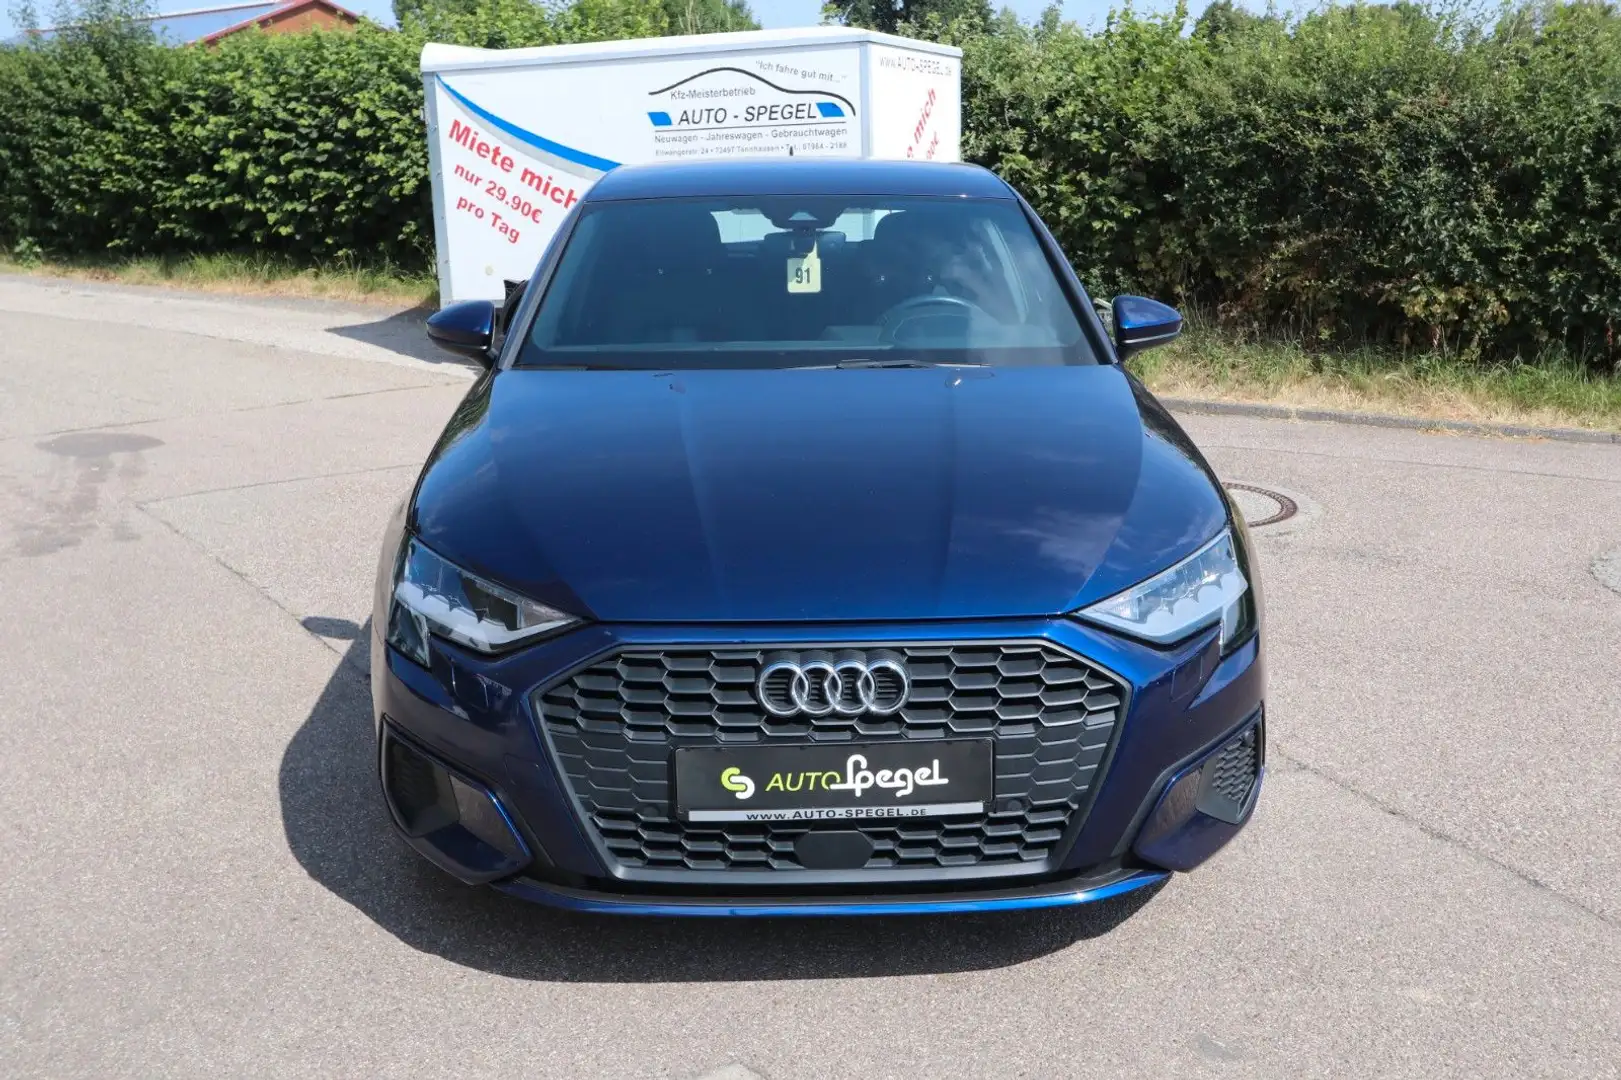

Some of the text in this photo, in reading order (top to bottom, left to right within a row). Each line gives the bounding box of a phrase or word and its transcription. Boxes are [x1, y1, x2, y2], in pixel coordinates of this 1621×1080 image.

[775, 63, 799, 75] fahre
[801, 69, 817, 79] gut
[670, 87, 756, 100] Kfz-Meisterbetrieb
[677, 108, 727, 125] AUTO
[744, 103, 817, 122] SPEGEL
[914, 88, 936, 144] mich
[655, 134, 698, 144] Neuwagen
[706, 130, 763, 142] Jahreswagen
[771, 128, 848, 138] Gebrauchtwagen
[449, 119, 578, 209] Miete mich
[454, 164, 543, 224] nur 29.90€
[456, 196, 520, 244] pro Tag
[796, 267, 811, 284] 91
[746, 808, 927, 821] www.AUTO-SPEGEL.DE
